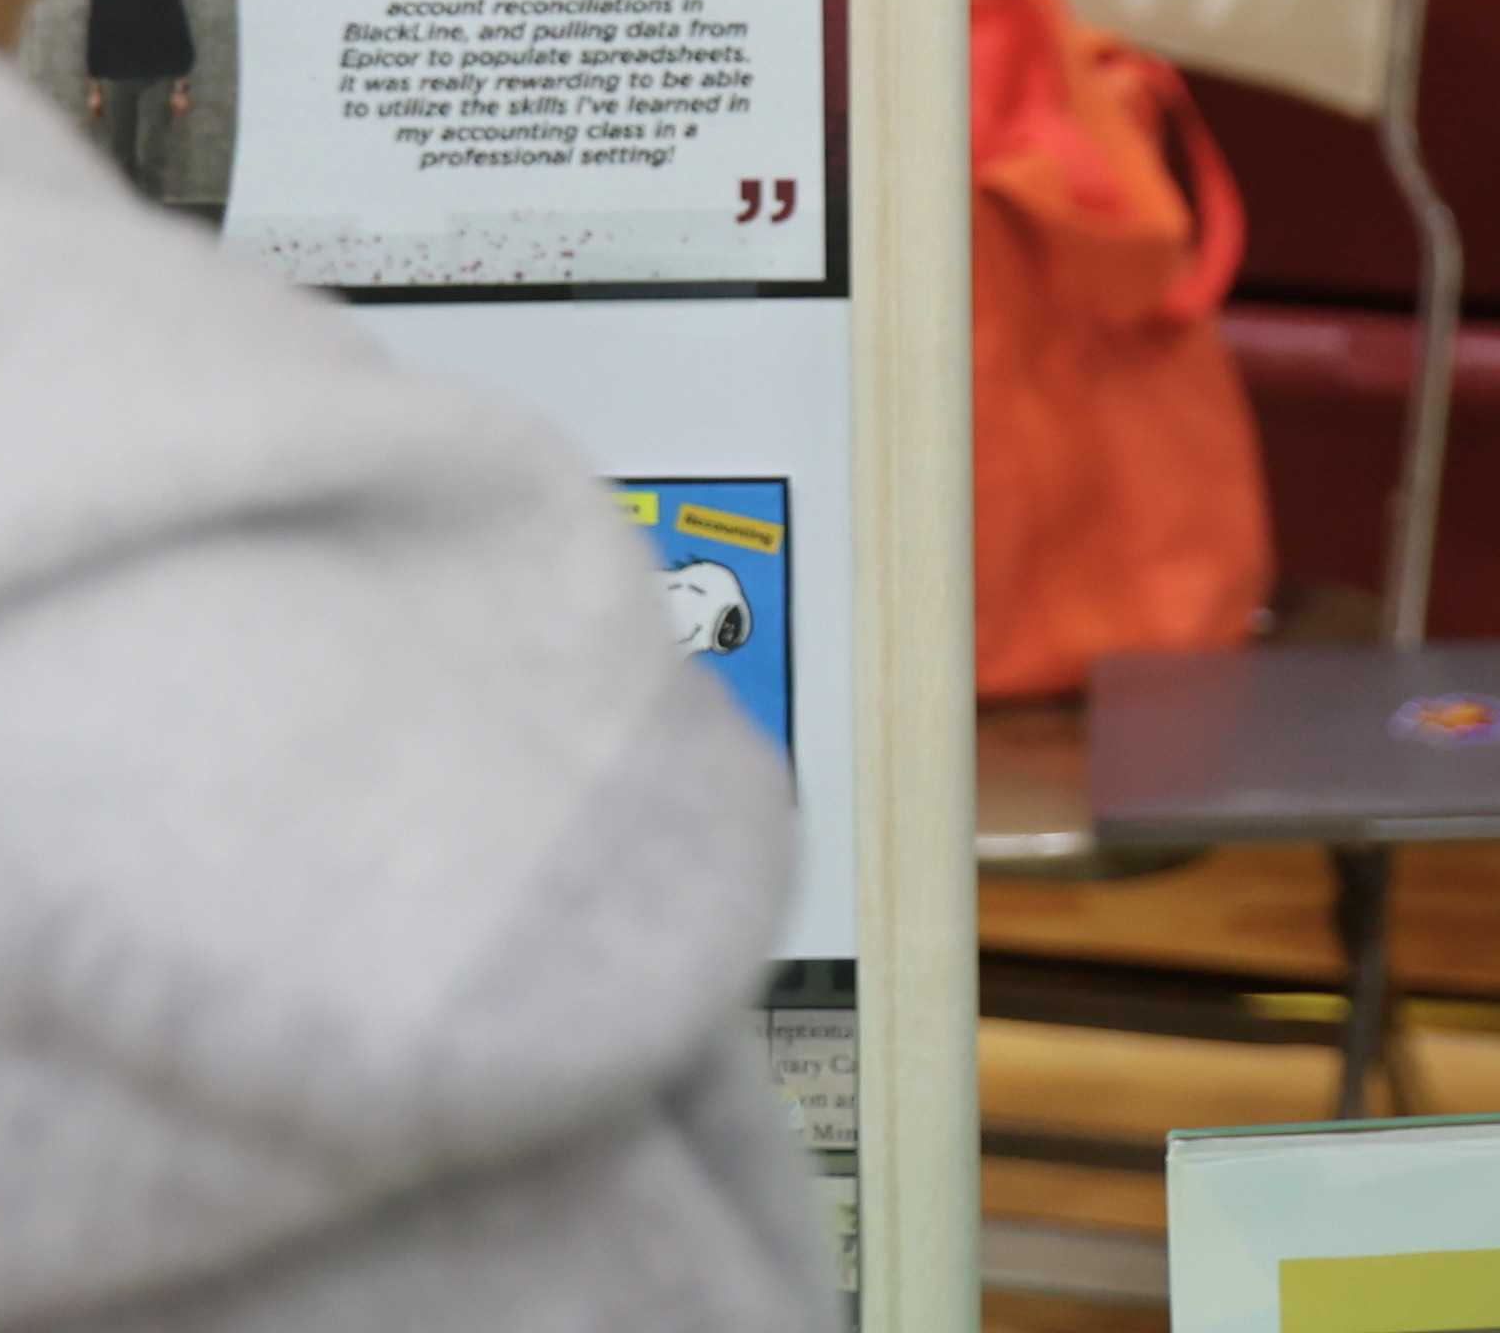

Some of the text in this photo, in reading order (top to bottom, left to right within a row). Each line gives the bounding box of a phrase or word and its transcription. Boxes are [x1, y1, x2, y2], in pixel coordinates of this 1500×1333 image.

[343, 19, 748, 43] BlackLine, and pulling data from
[340, 48, 420, 70] Epicor
[427, 49, 454, 67] to
[460, 46, 571, 69] populate
[364, 77, 411, 92] was
[418, 74, 487, 95] really
[494, 72, 620, 93] rewarding
[629, 71, 654, 89] to
[662, 70, 693, 89] be
[700, 70, 753, 89] able
[343, 99, 370, 118] to
[377, 98, 452, 118] utilize
[459, 98, 500, 117] the
[507, 96, 568, 116] skills
[627, 95, 722, 115] learned
[728, 93, 751, 113] in
[395, 120, 698, 146] my accounting class in a
[418, 144, 676, 170] professional setting!
